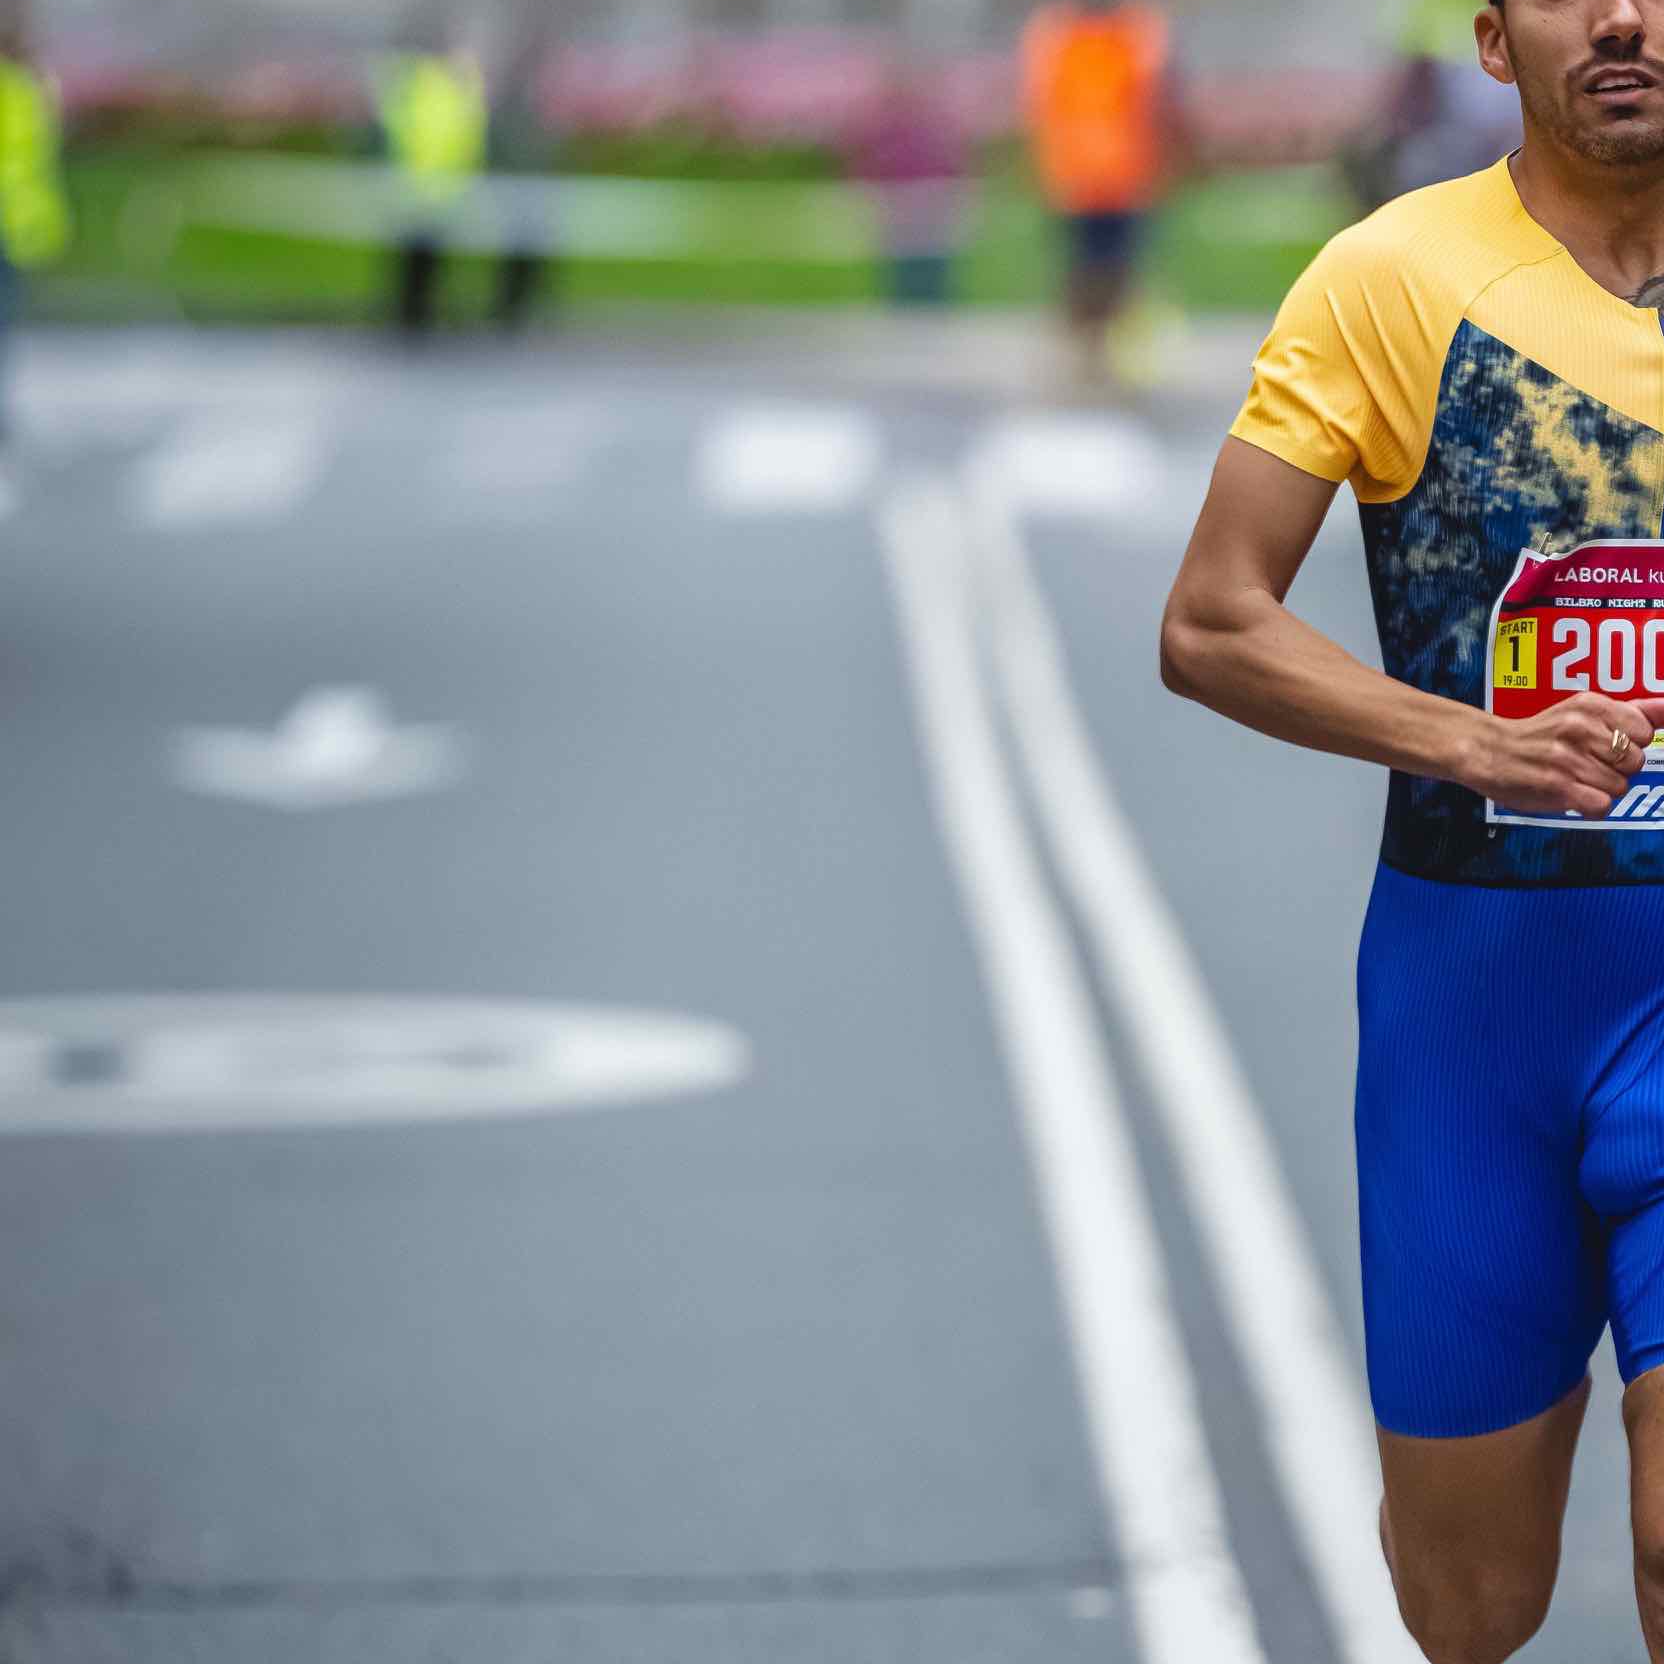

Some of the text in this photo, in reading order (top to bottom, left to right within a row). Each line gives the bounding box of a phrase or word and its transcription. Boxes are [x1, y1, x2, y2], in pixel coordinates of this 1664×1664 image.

[1555, 567, 1643, 584] LABORAL
[1555, 597, 1602, 609] BILBAO
[1608, 598, 1646, 609] NIGHT
[1500, 620, 1536, 636] START
[1508, 635, 1521, 673] 1
